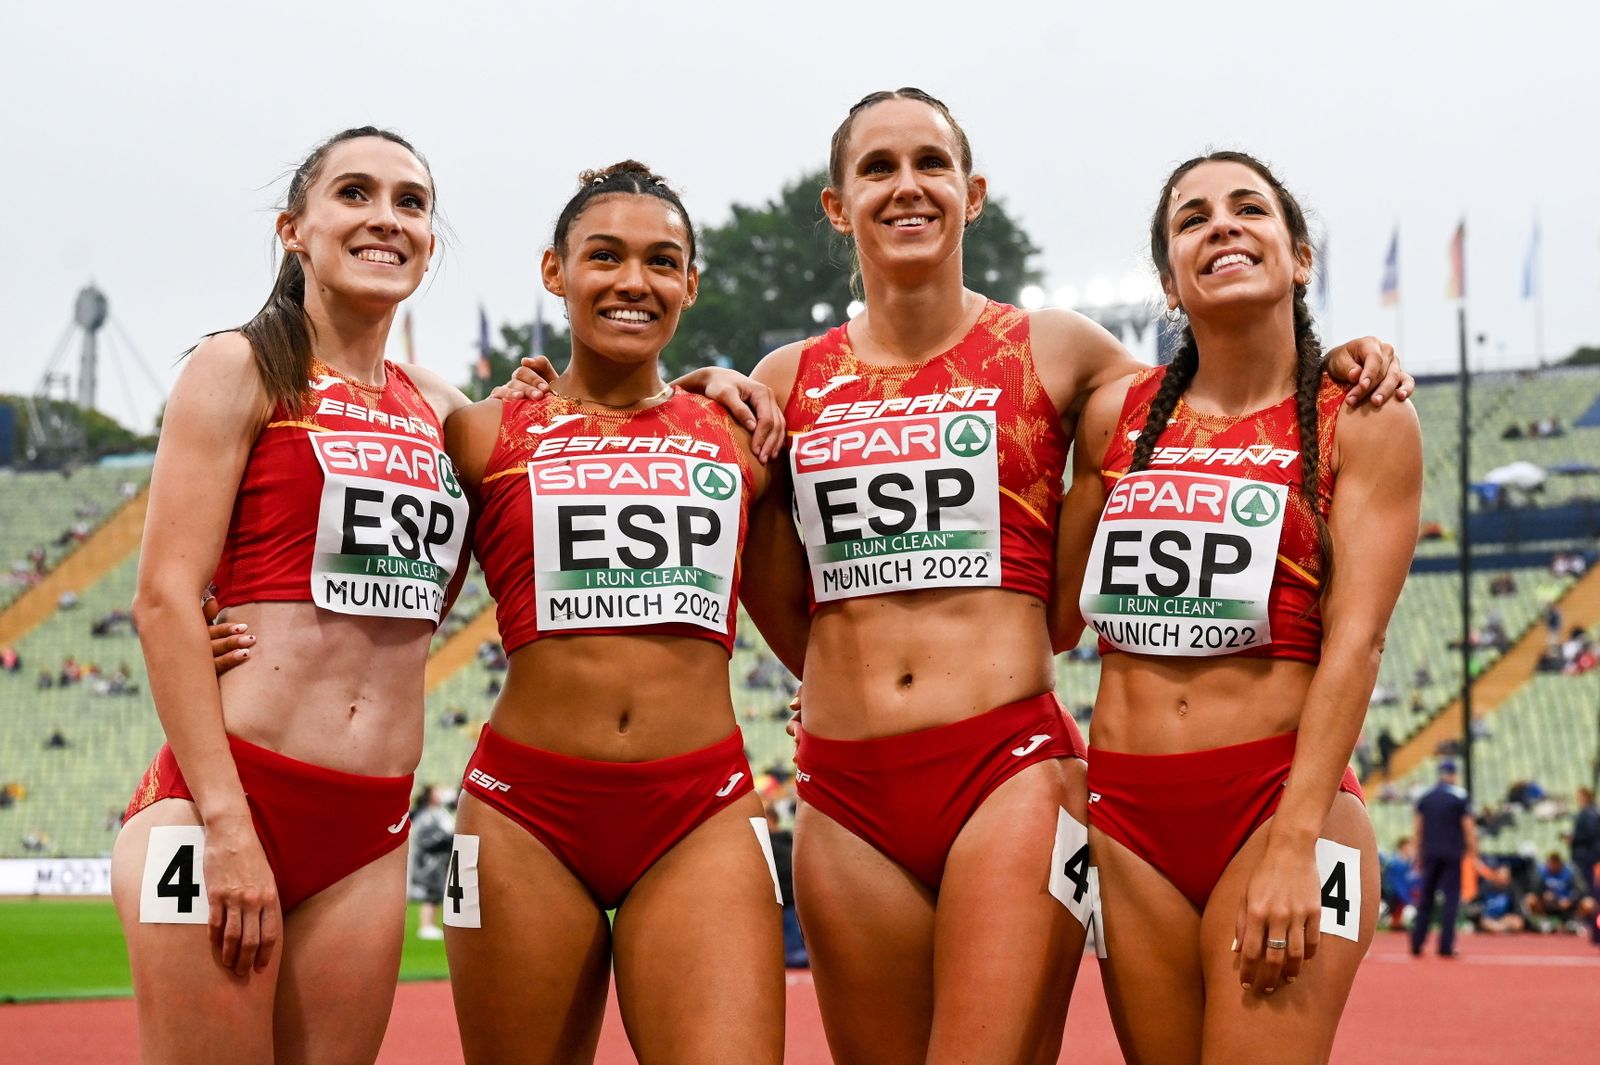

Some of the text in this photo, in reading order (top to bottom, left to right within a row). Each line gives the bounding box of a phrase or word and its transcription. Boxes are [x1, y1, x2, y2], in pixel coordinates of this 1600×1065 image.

[316, 397, 440, 444] ESPAÑA
[815, 387, 1002, 425] ESPAÑA
[322, 441, 437, 485] SPAR
[532, 435, 720, 458] ESPAÑA
[799, 424, 936, 466] SPAR
[538, 462, 685, 490] SPAR
[814, 468, 975, 544] ESP
[1107, 481, 1224, 516] SPAR
[340, 486, 454, 564] ESP
[557, 504, 721, 572] ESP
[365, 558, 371, 573] I
[376, 559, 409, 575] RUN
[844, 543, 849, 557] I
[853, 541, 887, 556] RUN
[1099, 530, 1252, 598] ESP
[586, 572, 590, 586] I
[597, 571, 635, 586] RUN
[823, 556, 989, 593] MUNICH 2022
[326, 579, 429, 611] MUNICH
[550, 592, 720, 624] MUNICH 2022
[1118, 597, 1123, 612] I
[1127, 598, 1159, 613] RUN
[1093, 620, 1256, 649] MUNICH 2022
[468, 767, 511, 792] ESP
[157, 844, 200, 913] 4
[447, 850, 464, 913] 4
[1063, 843, 1089, 904] 4
[1321, 861, 1350, 926] 4
